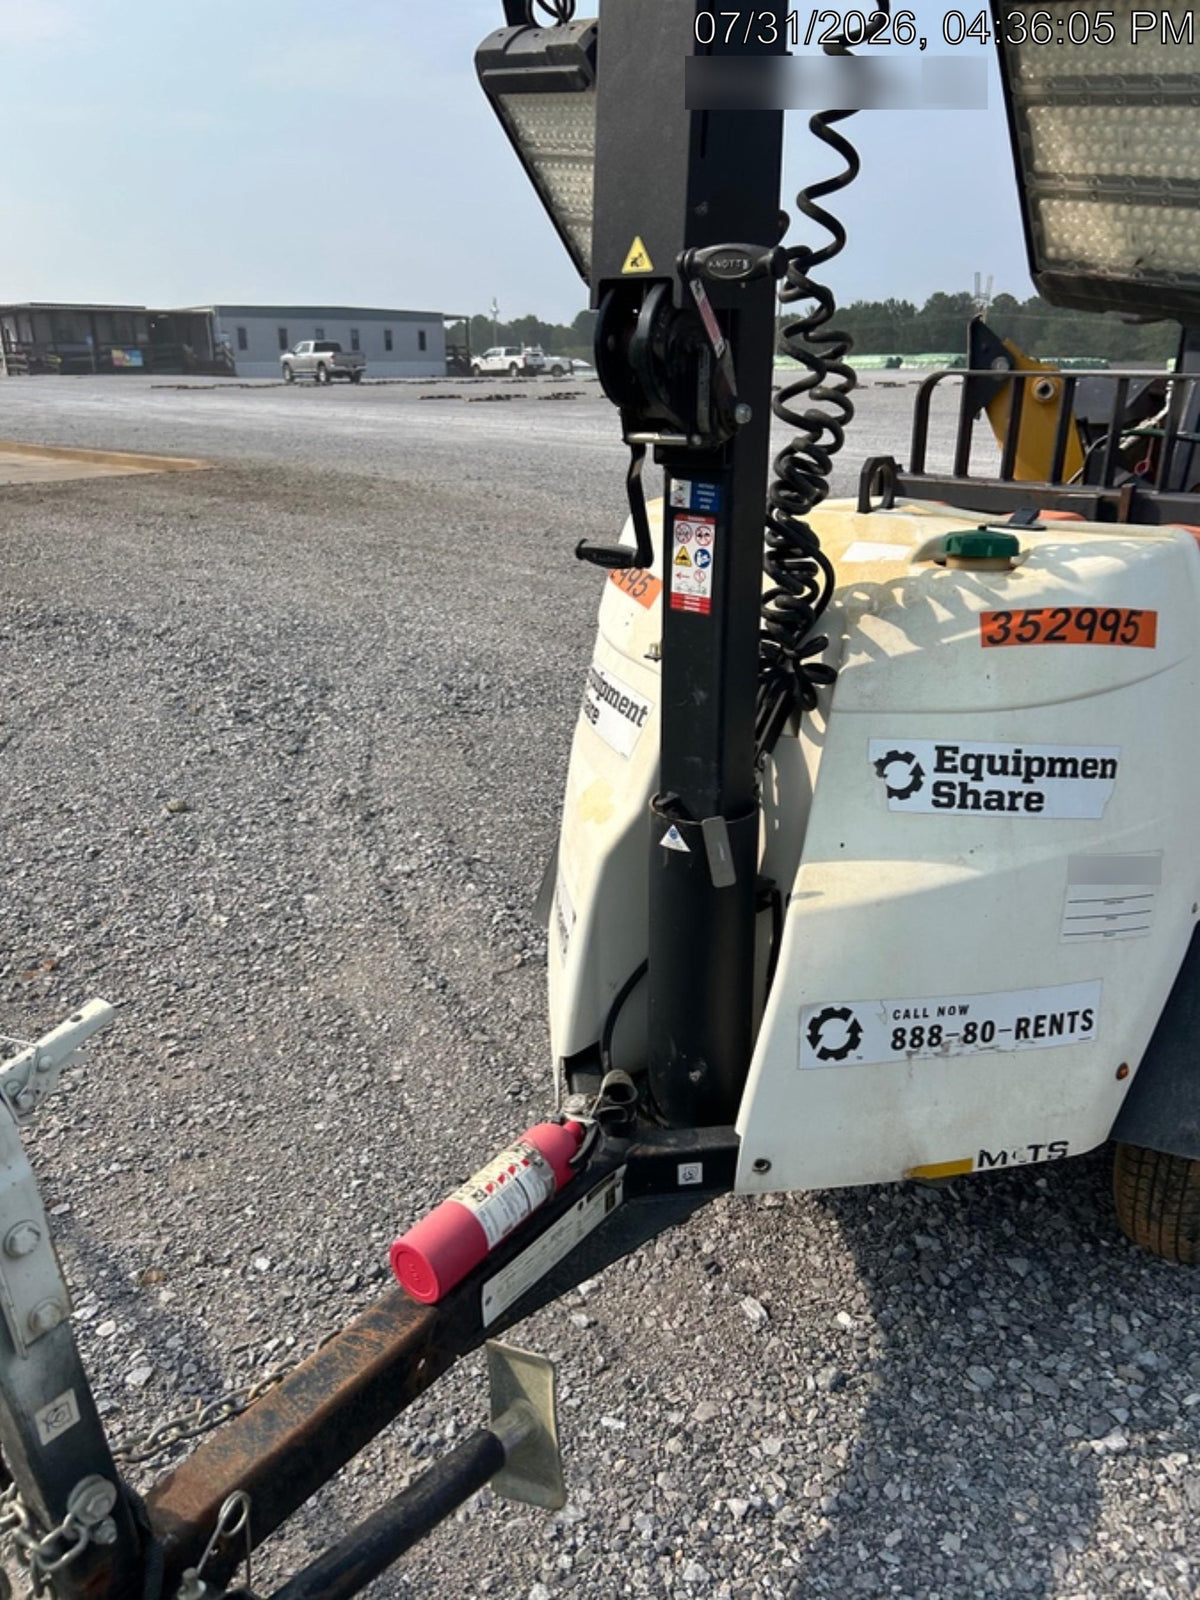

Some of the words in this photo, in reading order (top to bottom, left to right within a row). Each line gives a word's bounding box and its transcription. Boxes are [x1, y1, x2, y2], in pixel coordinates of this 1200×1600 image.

[986, 607, 1143, 645] 352995
[931, 780, 1045, 813] Share
[890, 1008, 1095, 1052] 888-80-RENTS
[892, 1008, 930, 1021] CALL
[936, 1004, 970, 1017] NOW
